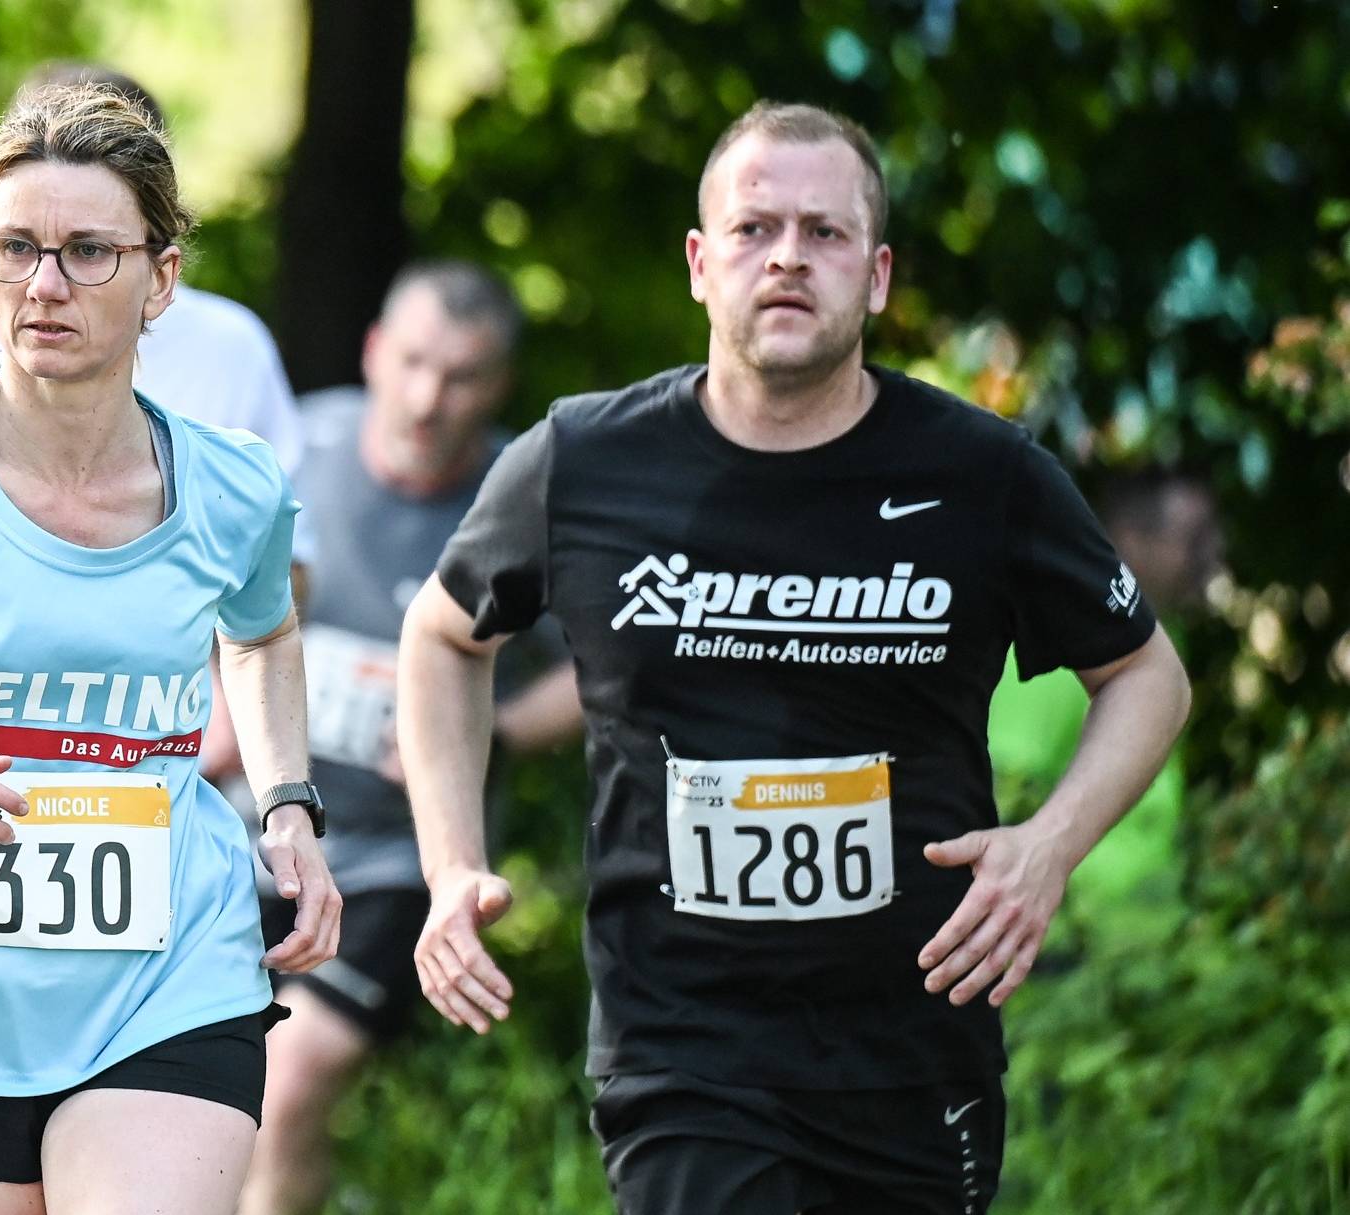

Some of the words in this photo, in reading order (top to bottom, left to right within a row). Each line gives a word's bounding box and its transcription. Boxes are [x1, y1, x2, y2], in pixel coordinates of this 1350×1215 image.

[680, 562, 952, 628] premio
[674, 633, 947, 664] Reifen+Autoservice
[60, 738, 101, 757] Das
[110, 741, 198, 763] Authaus.
[36, 797, 110, 818] NICOLE
[755, 783, 826, 804] DENNIS
[693, 818, 872, 907] 1286
